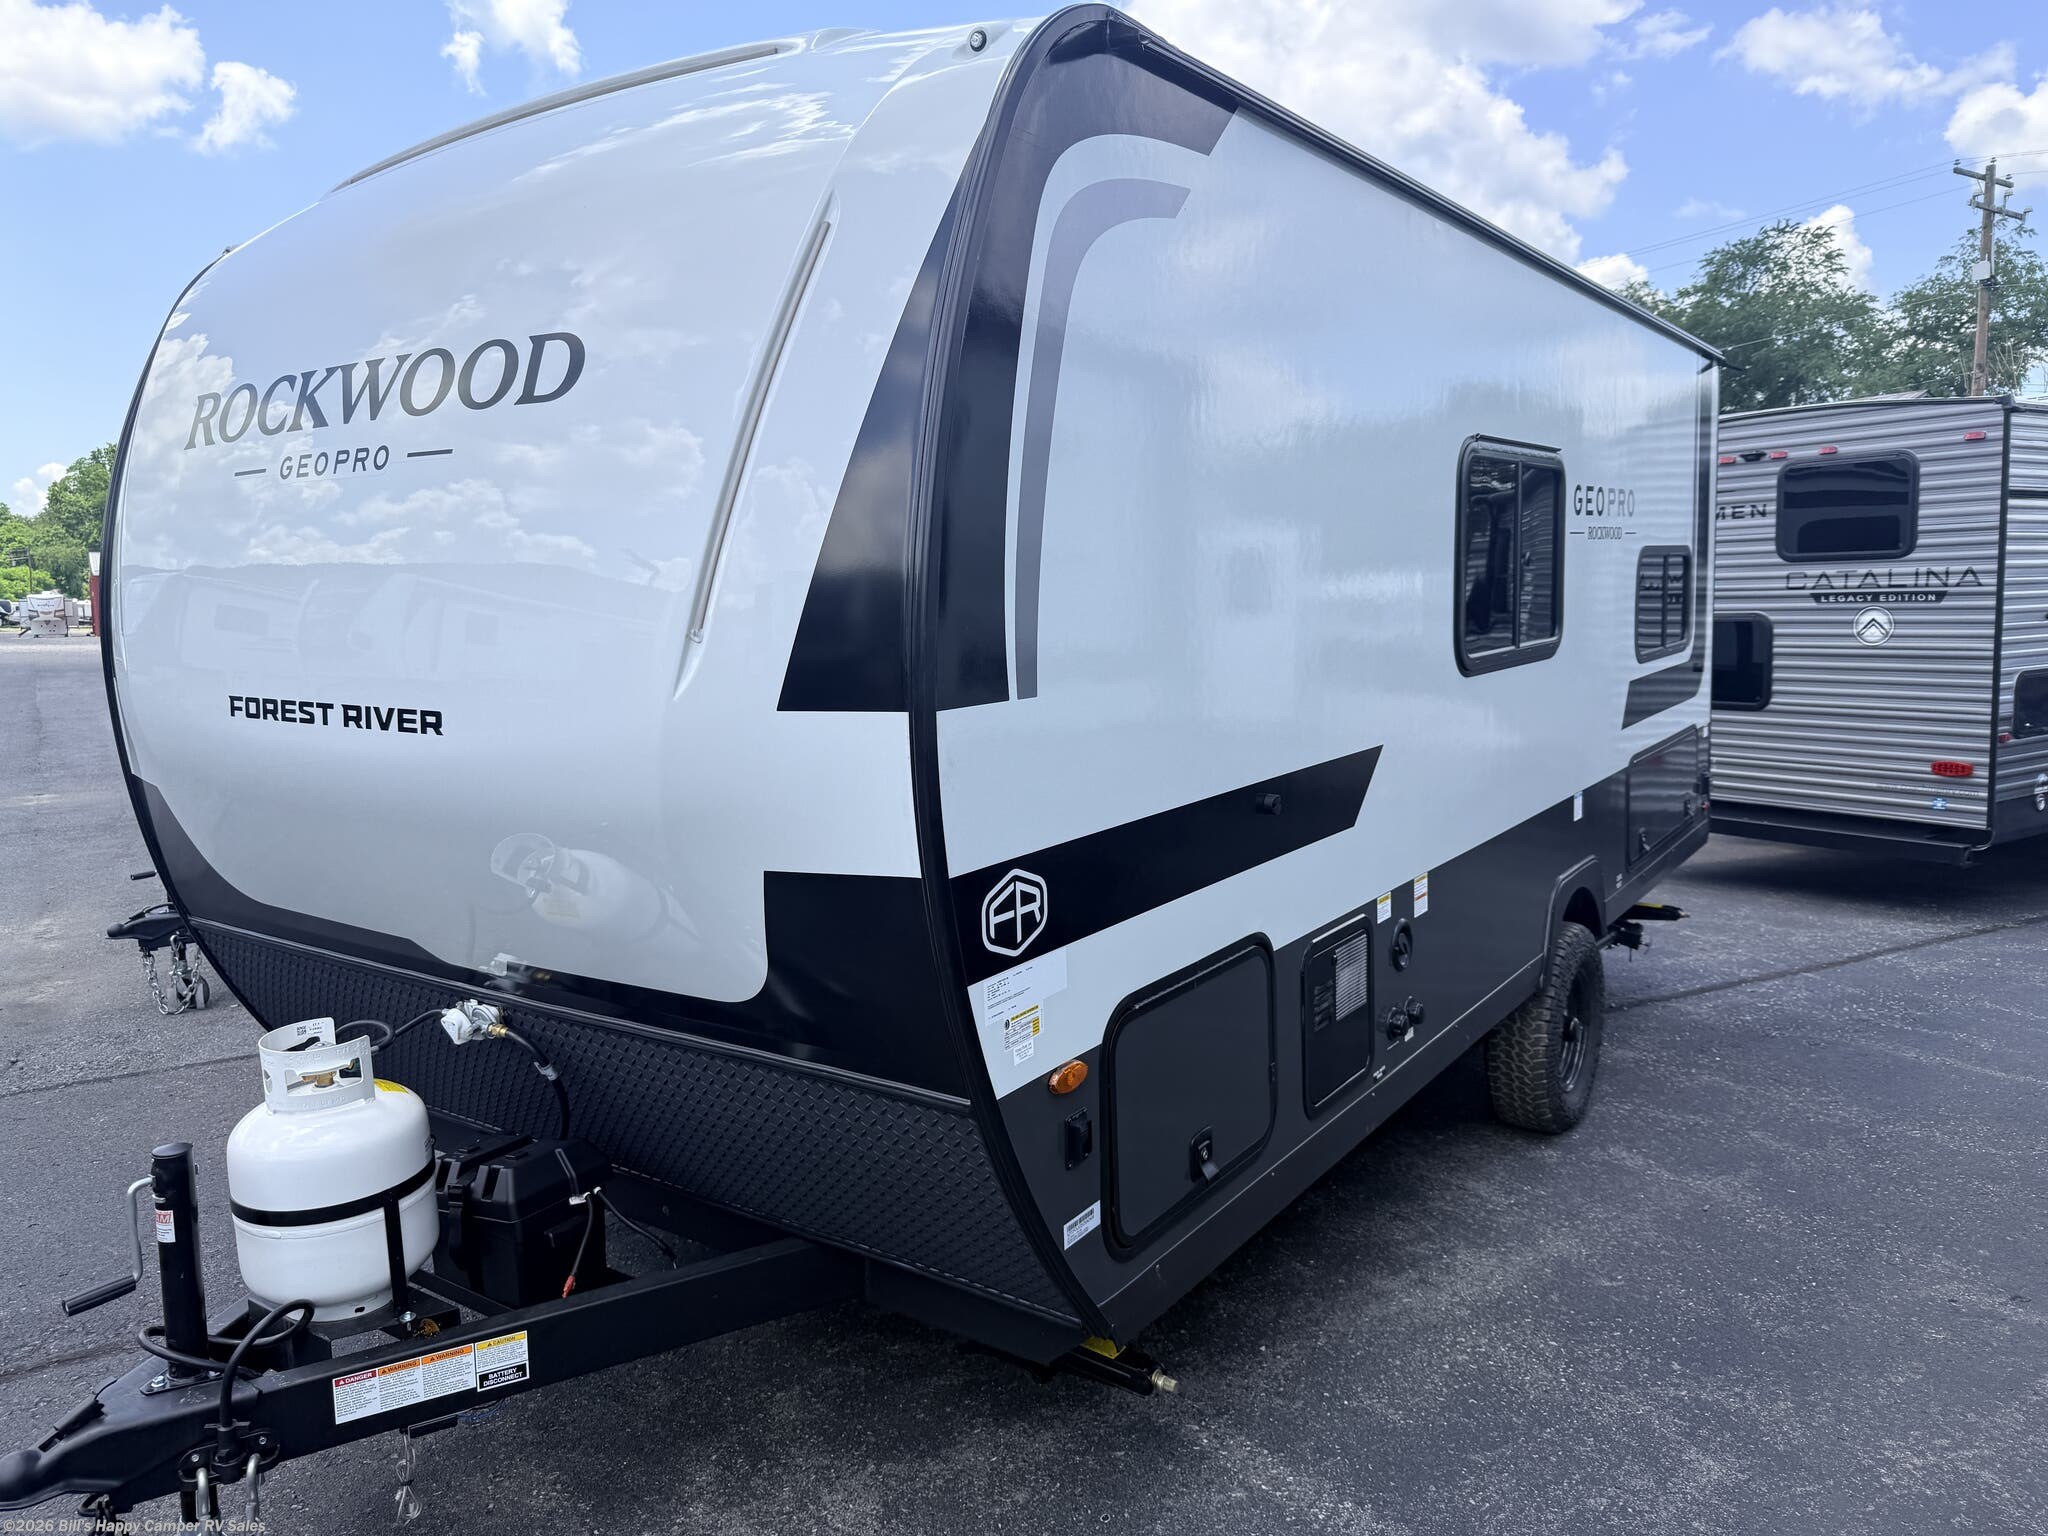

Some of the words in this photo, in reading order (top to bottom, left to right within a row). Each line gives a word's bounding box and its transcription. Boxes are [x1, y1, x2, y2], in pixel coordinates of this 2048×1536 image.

[184, 332, 586, 451] ROCKWOOD
[279, 445, 390, 480] GEOPRO
[1573, 484, 1635, 517] GEOPRO
[1587, 526, 1623, 540] ROCKWOOD
[1785, 566, 1984, 590] CATALINA
[1820, 594, 1873, 603] LEGACY
[1879, 593, 1936, 602] EDITION
[228, 695, 334, 726] FOREST
[341, 703, 444, 736] RIVER
[436, 1349, 465, 1360] WARNING
[388, 1361, 417, 1372] WARNING
[488, 1367, 517, 1380] BATTERY
[345, 1372, 373, 1384] DANGER
[483, 1372, 523, 1387] DISCONNECT
